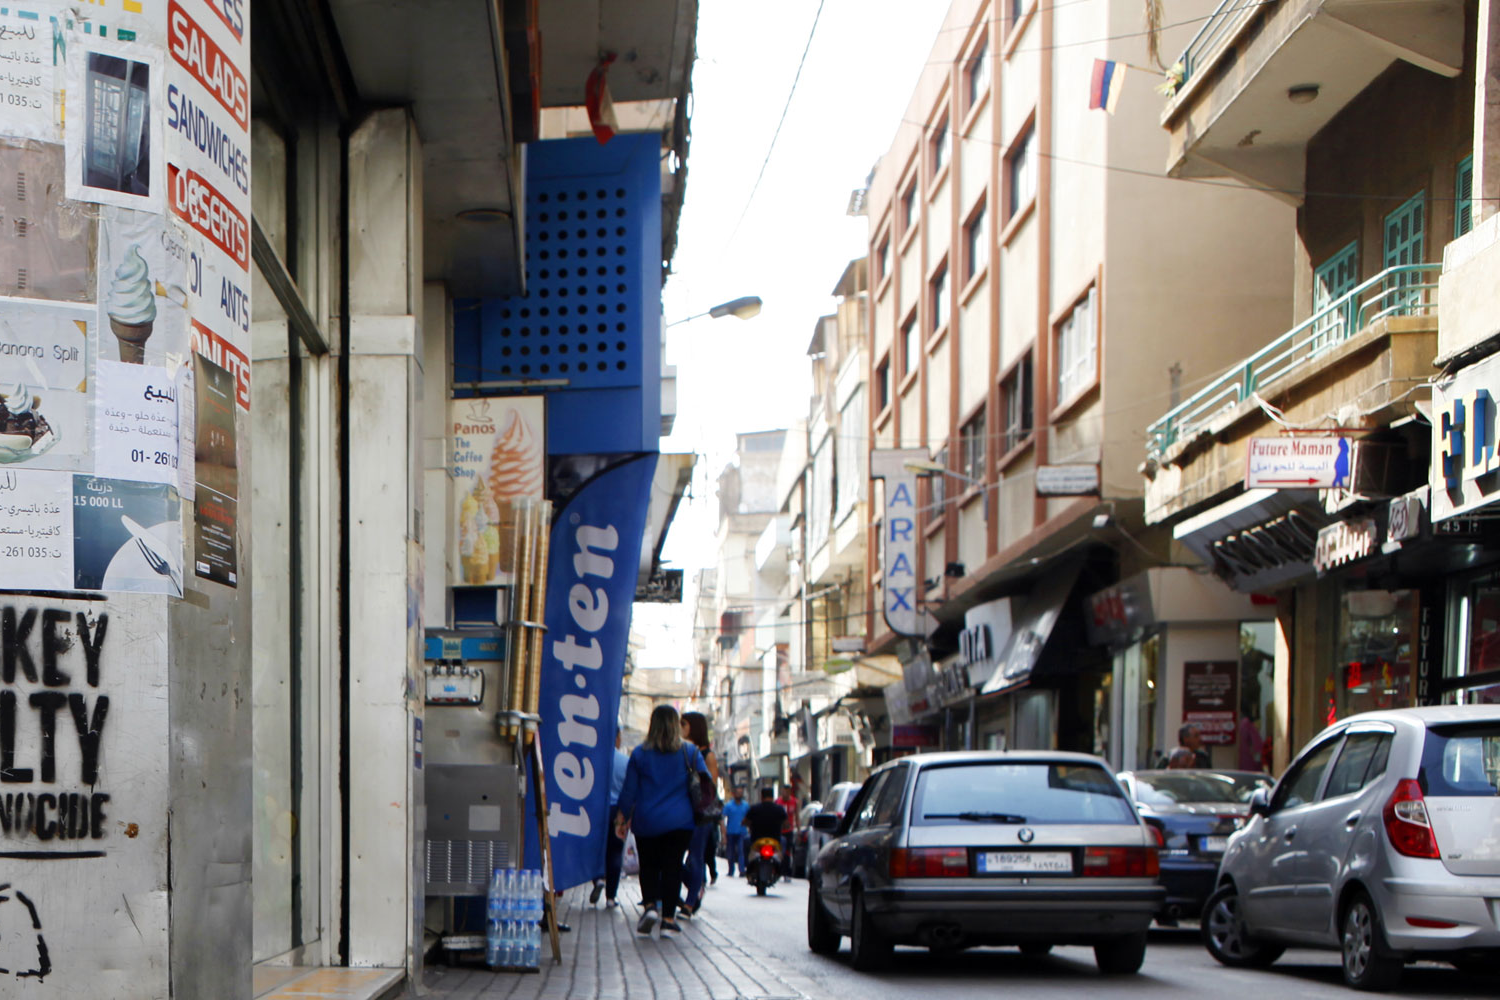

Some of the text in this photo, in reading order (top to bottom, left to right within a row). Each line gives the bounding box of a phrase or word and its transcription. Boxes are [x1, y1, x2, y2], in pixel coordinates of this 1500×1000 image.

[171, 10, 247, 123] SALADS
[7, 95, 28, 107] 035
[167, 83, 248, 196] SANDWICHES
[53, 345, 79, 363] Split
[454, 422, 496, 435] Panos
[455, 437, 470, 449] The
[1252, 440, 1332, 456] Future Maman
[454, 452, 483, 464] Coffee
[454, 466, 476, 478] Shop
[74, 495, 124, 508] 15 000 LL
[28, 547, 47, 558] 035
[889, 483, 913, 612] ARAX
